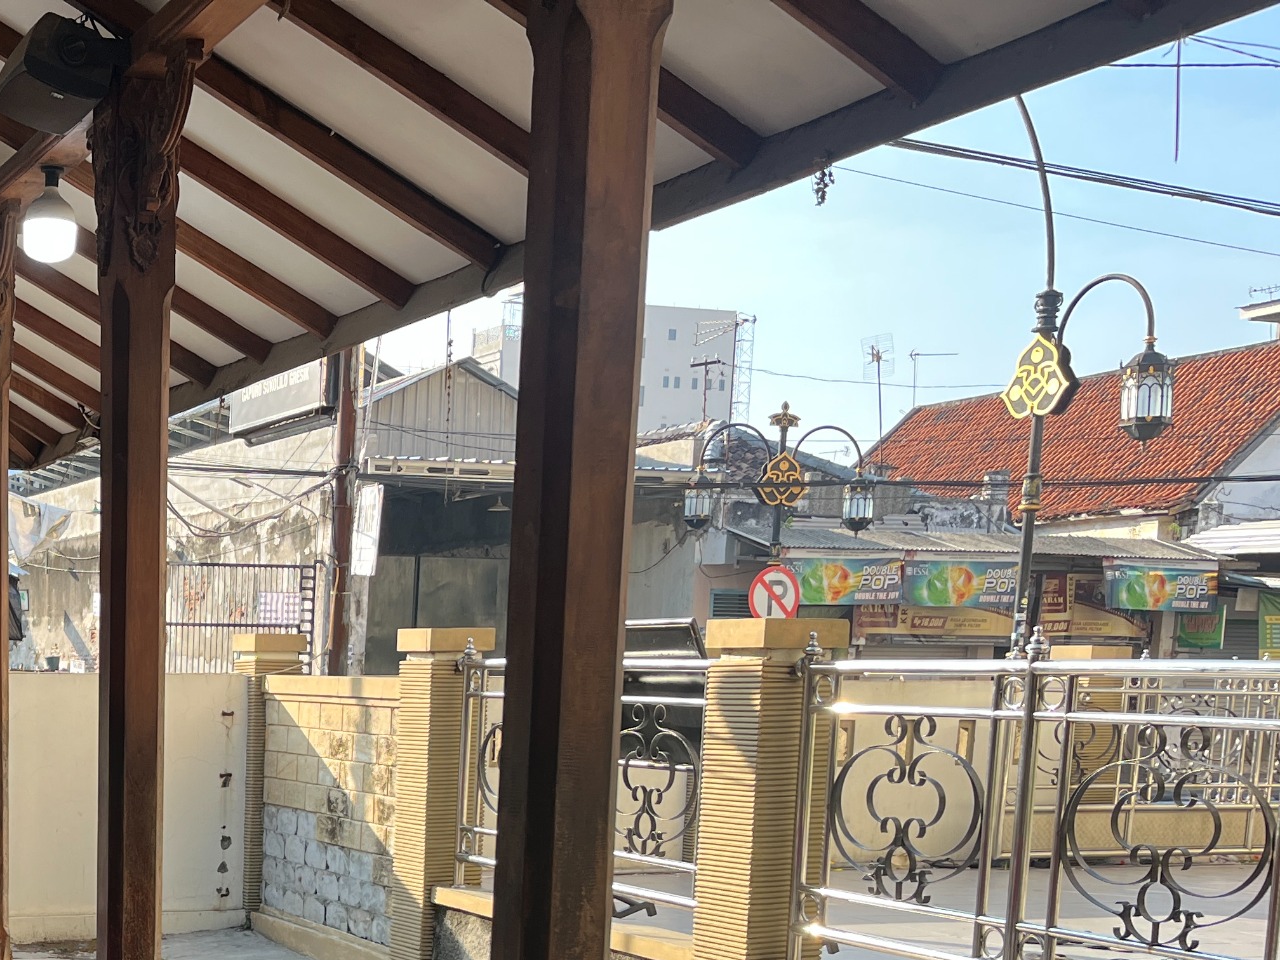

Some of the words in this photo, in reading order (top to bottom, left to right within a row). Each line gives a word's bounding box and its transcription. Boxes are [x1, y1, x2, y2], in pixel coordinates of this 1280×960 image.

[863, 565, 899, 575] DOUBLE
[858, 575, 899, 590] POP
[982, 578, 1016, 593] POP
[1177, 575, 1208, 586] DOUBLE
[1174, 584, 1208, 598] POP
